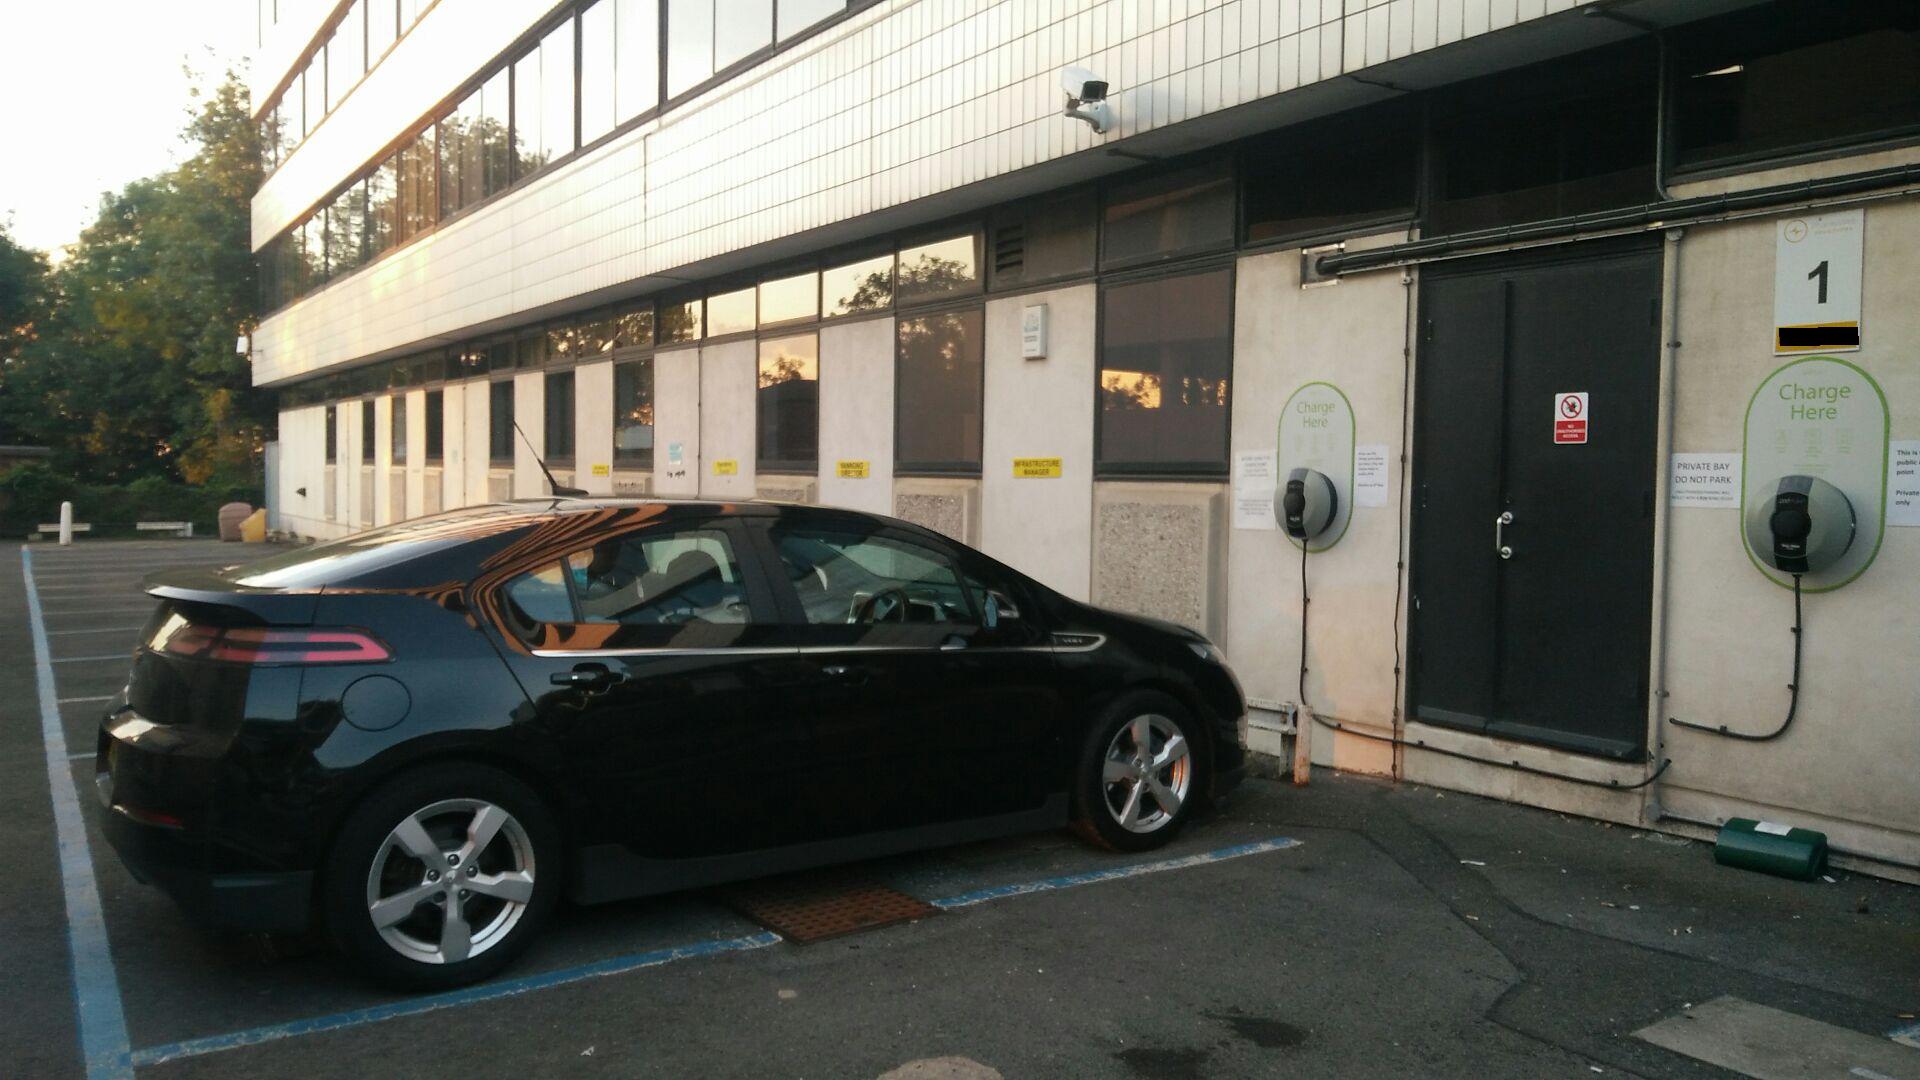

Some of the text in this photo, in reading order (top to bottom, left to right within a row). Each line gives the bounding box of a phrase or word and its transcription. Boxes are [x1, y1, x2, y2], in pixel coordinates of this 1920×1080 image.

[1807, 260, 1828, 304] 1
[1779, 383, 1851, 403] Charge
[1296, 400, 1336, 416] Charge
[1791, 404, 1838, 420] Here
[1303, 416, 1329, 428] Here
[1677, 462, 1730, 471] PRIVATE BAY
[1675, 475, 1732, 484] DO NOT PARK
[1895, 499, 1911, 507] only
